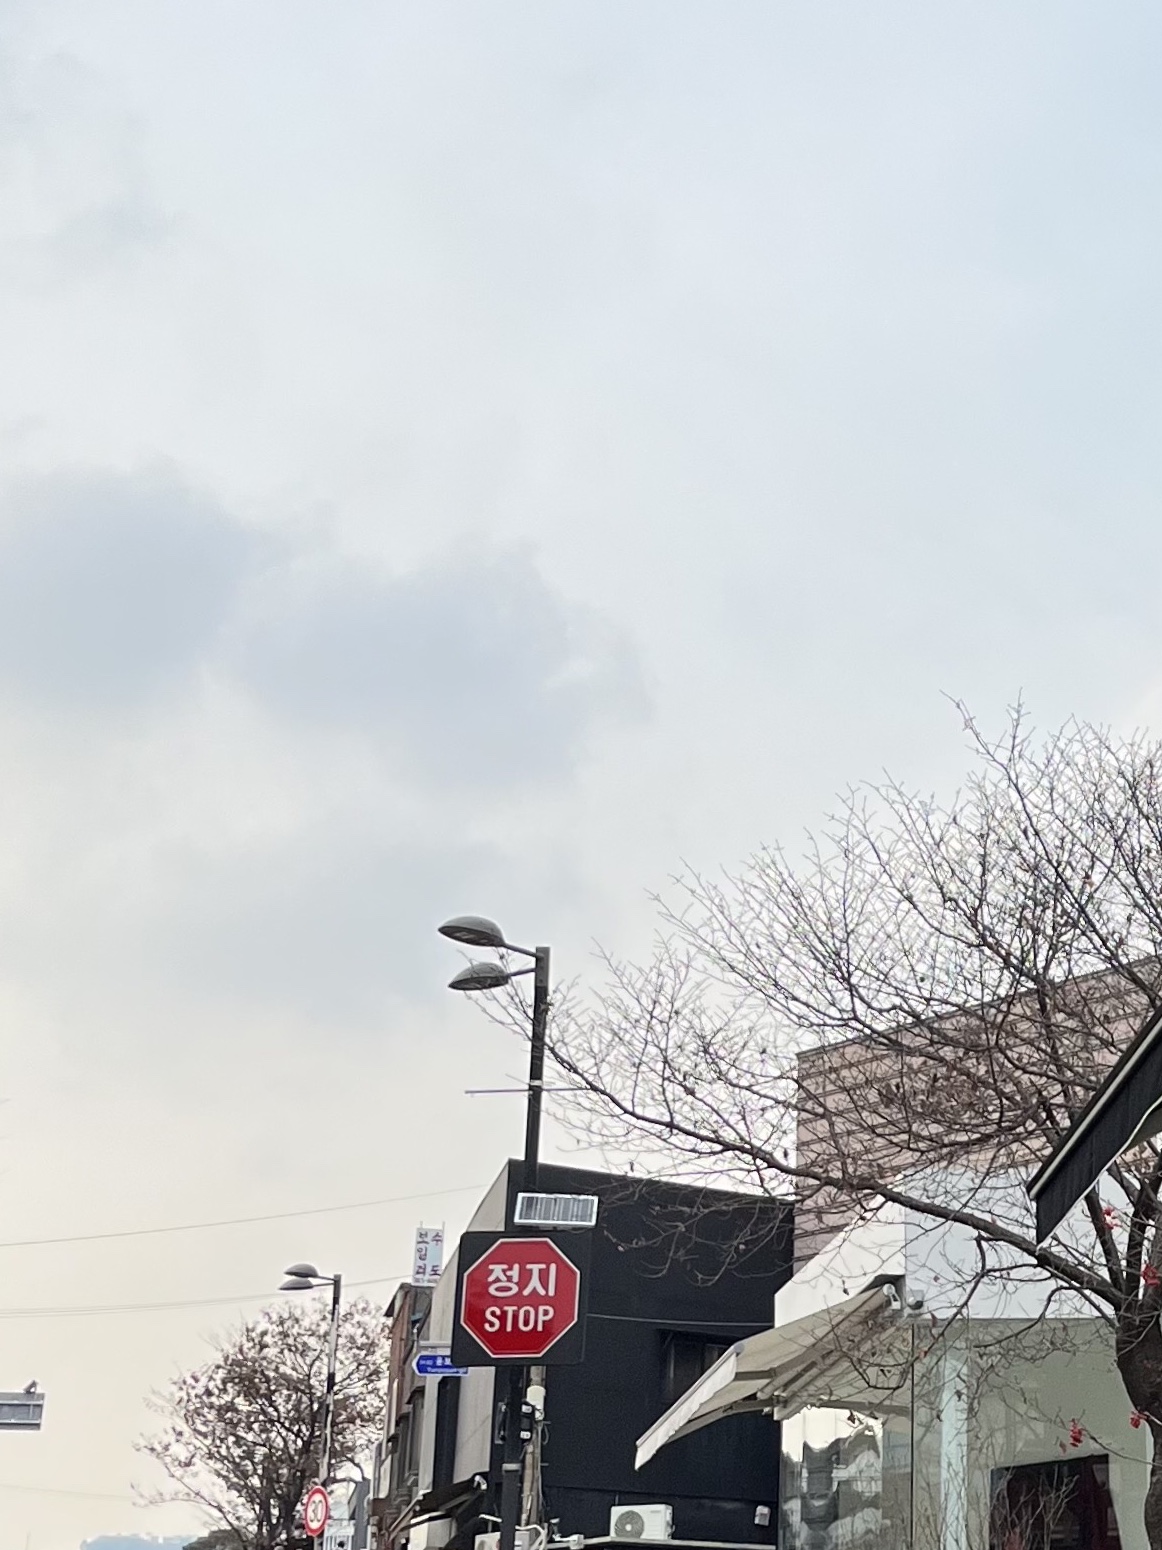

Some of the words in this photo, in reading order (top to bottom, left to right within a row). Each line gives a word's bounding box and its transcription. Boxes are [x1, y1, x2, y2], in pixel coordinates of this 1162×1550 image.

[487, 1262, 557, 1298] 정지
[483, 1304, 555, 1333] STOP
[309, 1499, 323, 1523] 30
